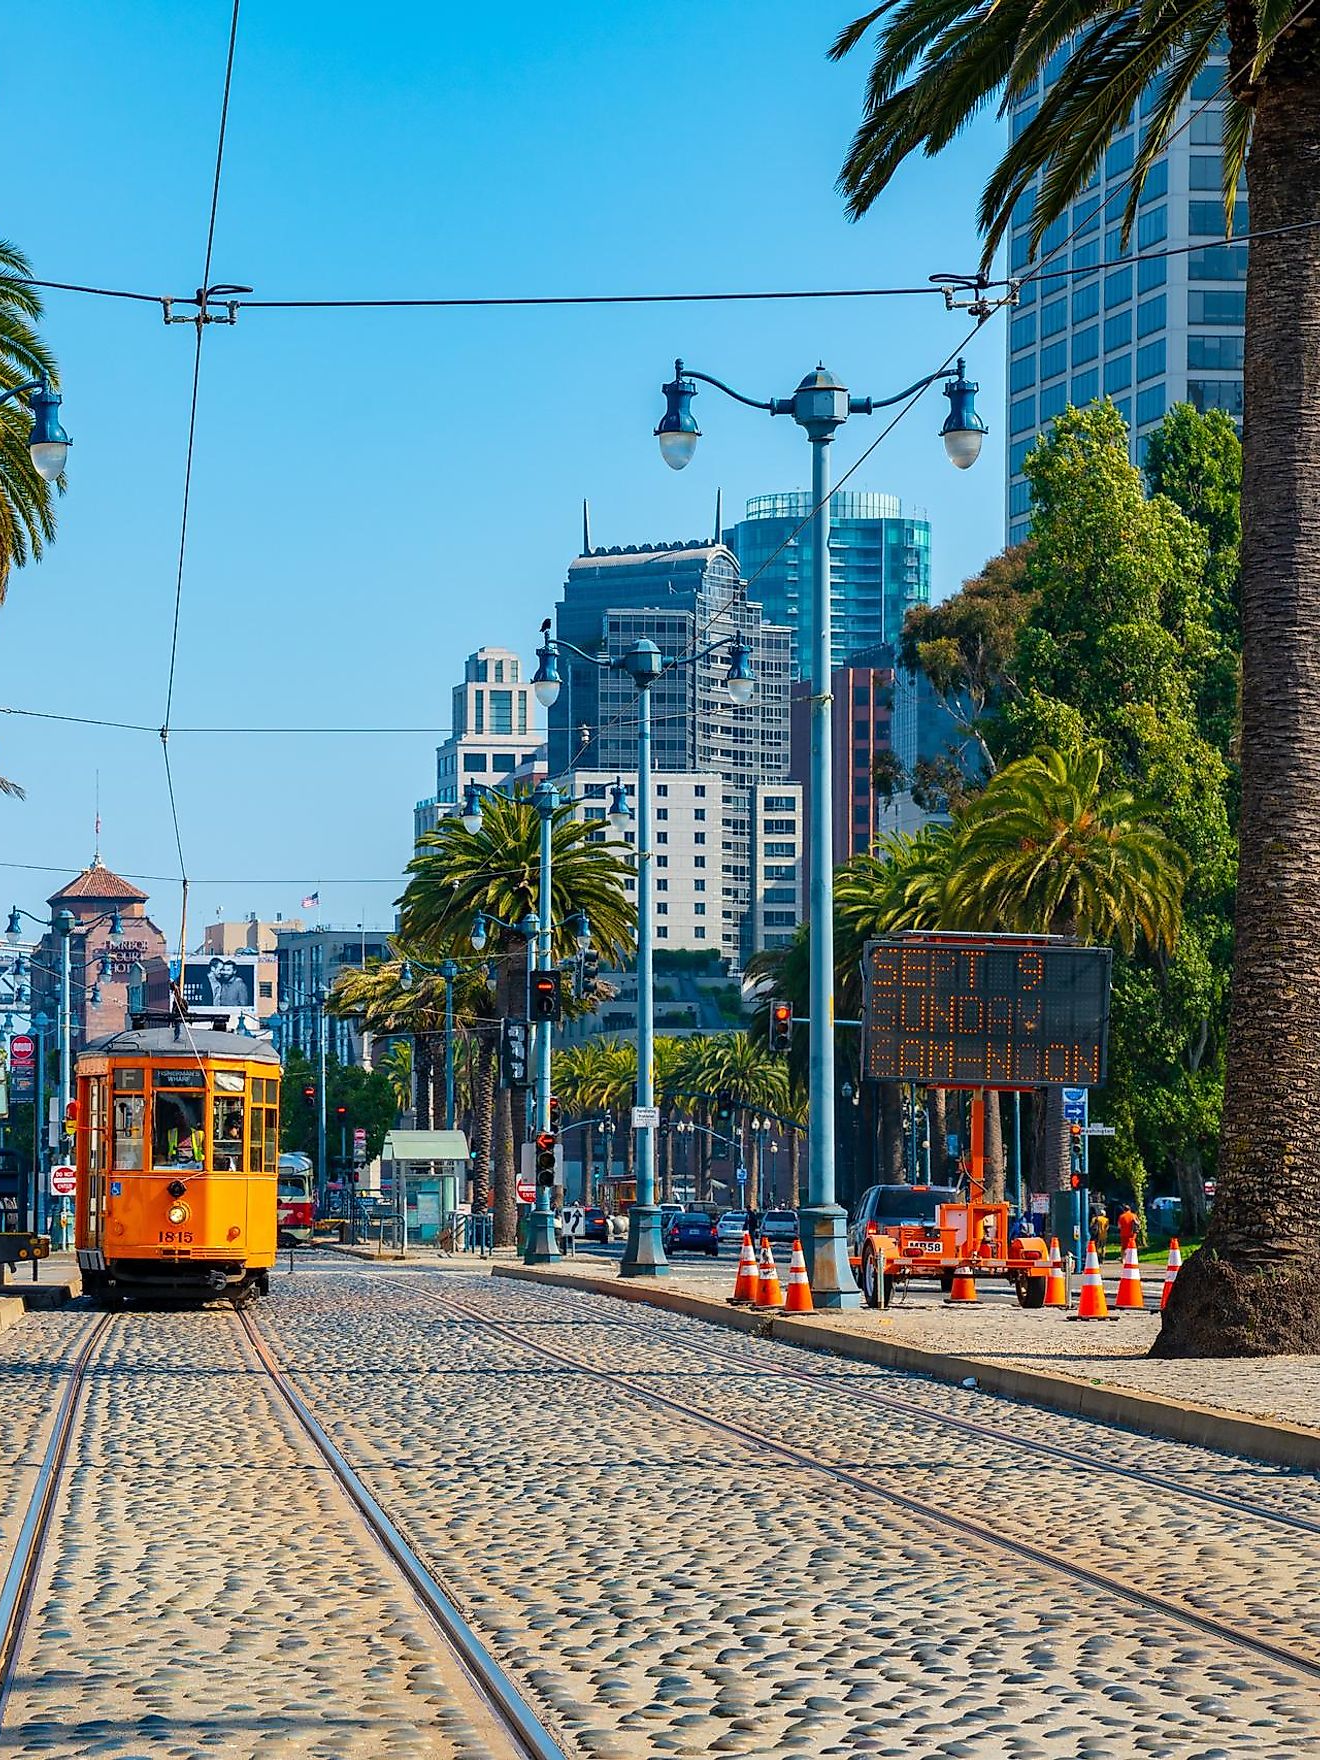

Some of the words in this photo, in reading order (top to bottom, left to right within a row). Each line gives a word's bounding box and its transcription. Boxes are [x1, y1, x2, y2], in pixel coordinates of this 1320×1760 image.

[872, 948, 985, 989] SEPT
[1018, 951, 1044, 991] 9
[871, 993, 1042, 1036] SUNDAY
[121, 1069, 137, 1088] F
[159, 1231, 193, 1244] 1815
